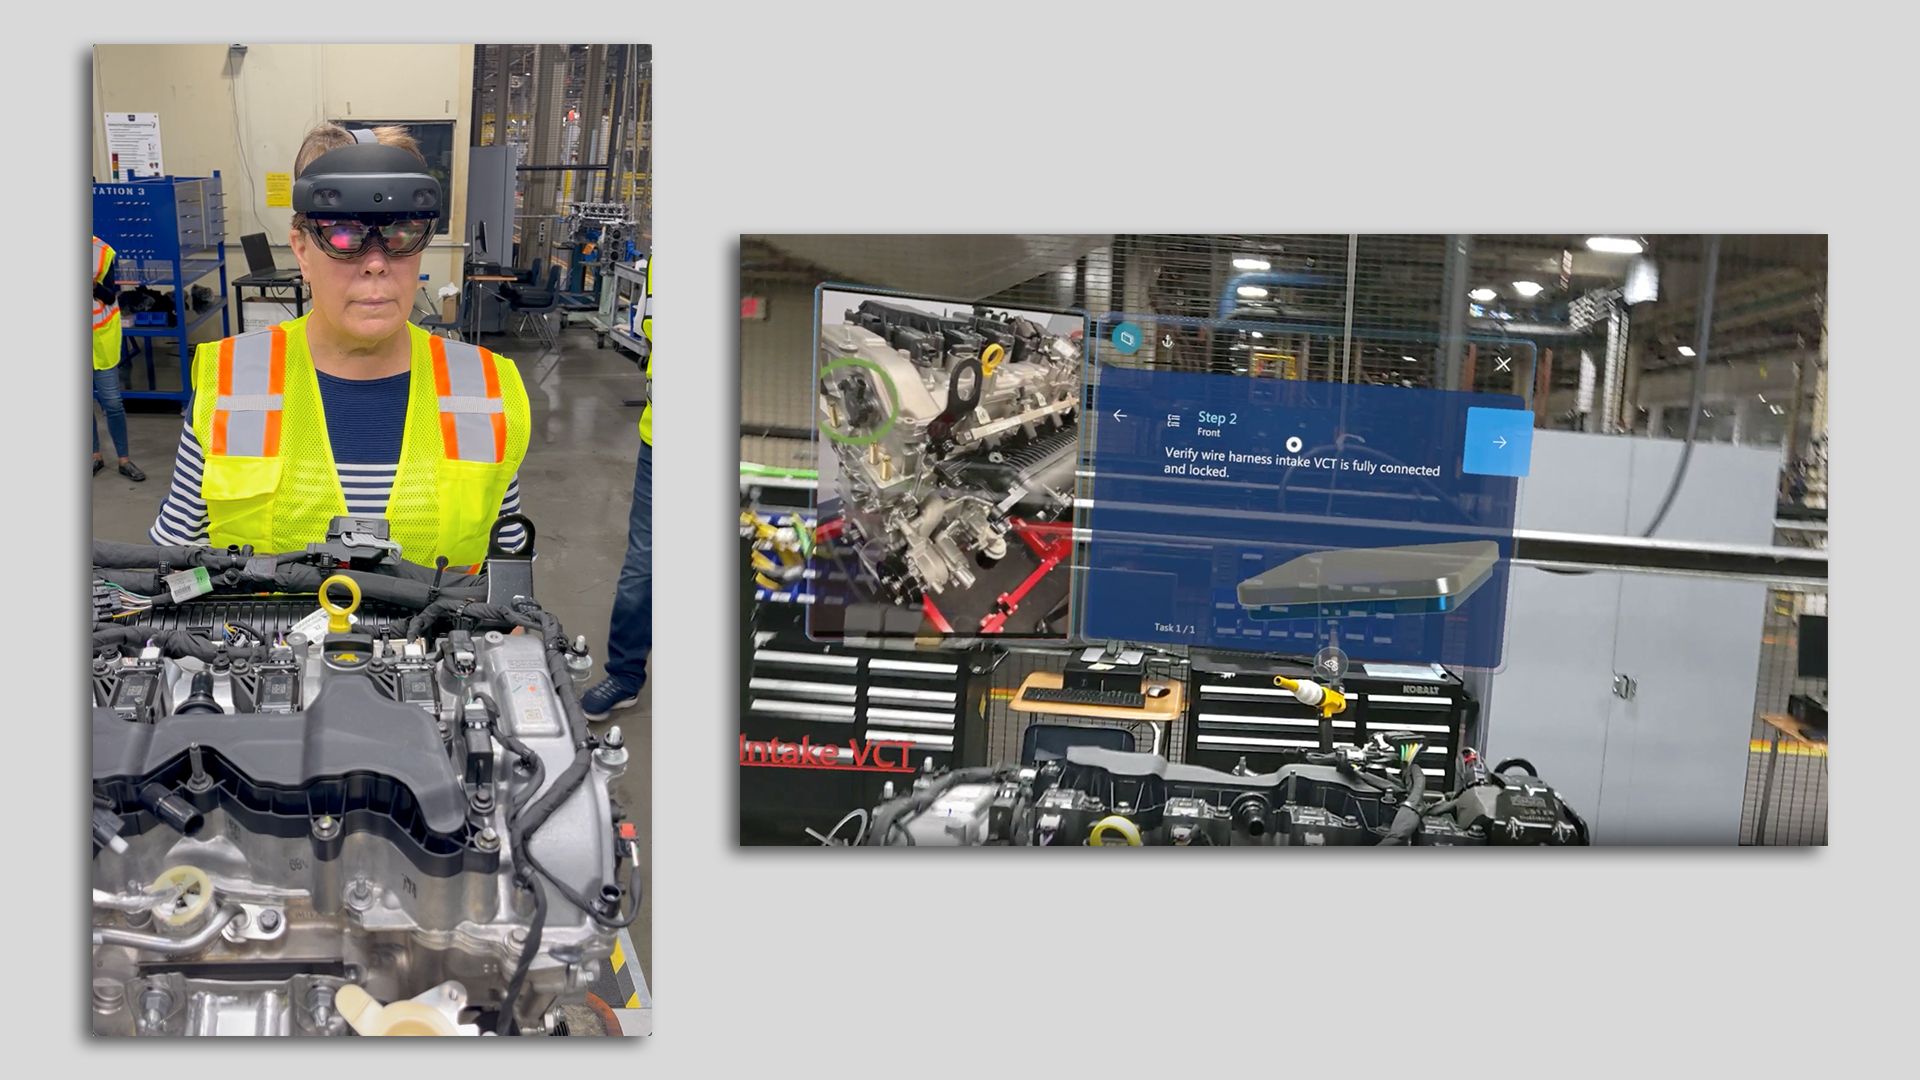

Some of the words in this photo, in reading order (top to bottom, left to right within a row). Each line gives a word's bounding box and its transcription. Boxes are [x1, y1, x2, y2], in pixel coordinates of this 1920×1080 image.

[1198, 411, 1226, 426] Step
[1229, 413, 1237, 425] 2
[1197, 427, 1221, 437] Front
[1165, 447, 1199, 462] Verify
[1201, 450, 1225, 461] wire
[1229, 451, 1272, 465] harness
[1275, 455, 1311, 467] intake
[1314, 457, 1337, 469] VCT
[1340, 459, 1349, 470] is
[1352, 460, 1377, 475] fully
[1380, 465, 1440, 477] connected
[1164, 464, 1185, 474] and
[1189, 465, 1230, 478] locked.
[1154, 622, 1174, 632] Task
[1402, 685, 1440, 695] KOBALT
[740, 733, 839, 766] Intake
[849, 738, 917, 768] VCT
